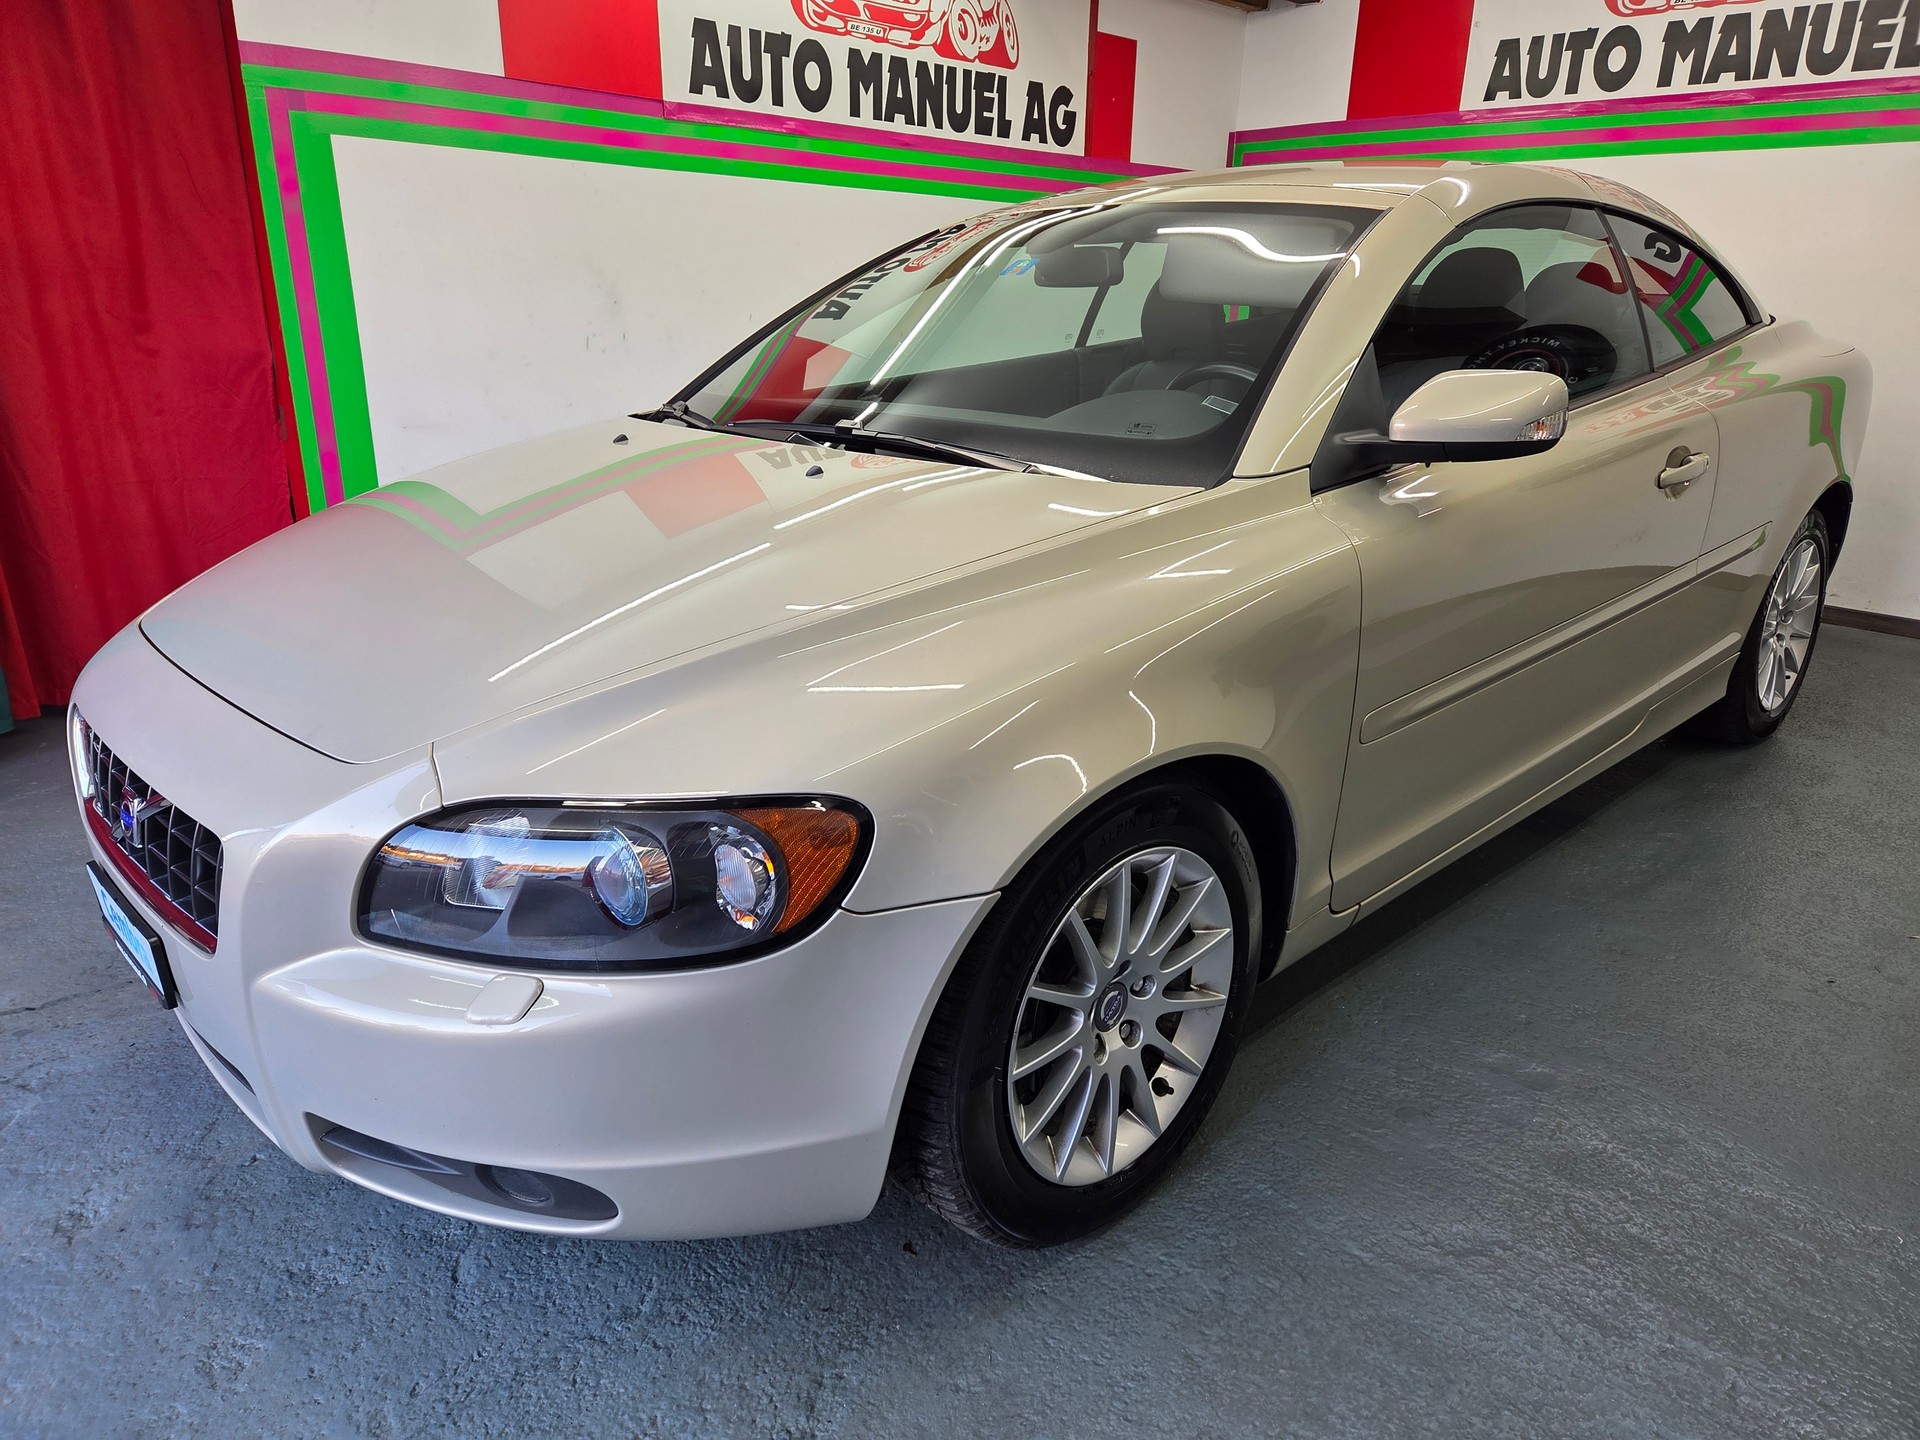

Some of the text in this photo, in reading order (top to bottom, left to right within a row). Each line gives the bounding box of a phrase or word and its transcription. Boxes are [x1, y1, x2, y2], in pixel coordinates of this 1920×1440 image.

[850, 23, 861, 31] BE
[862, 26, 875, 34] 135
[1483, 0, 1920, 102] AUTO MANUEL
[689, 17, 1077, 147] AUTO MANUEL AG
